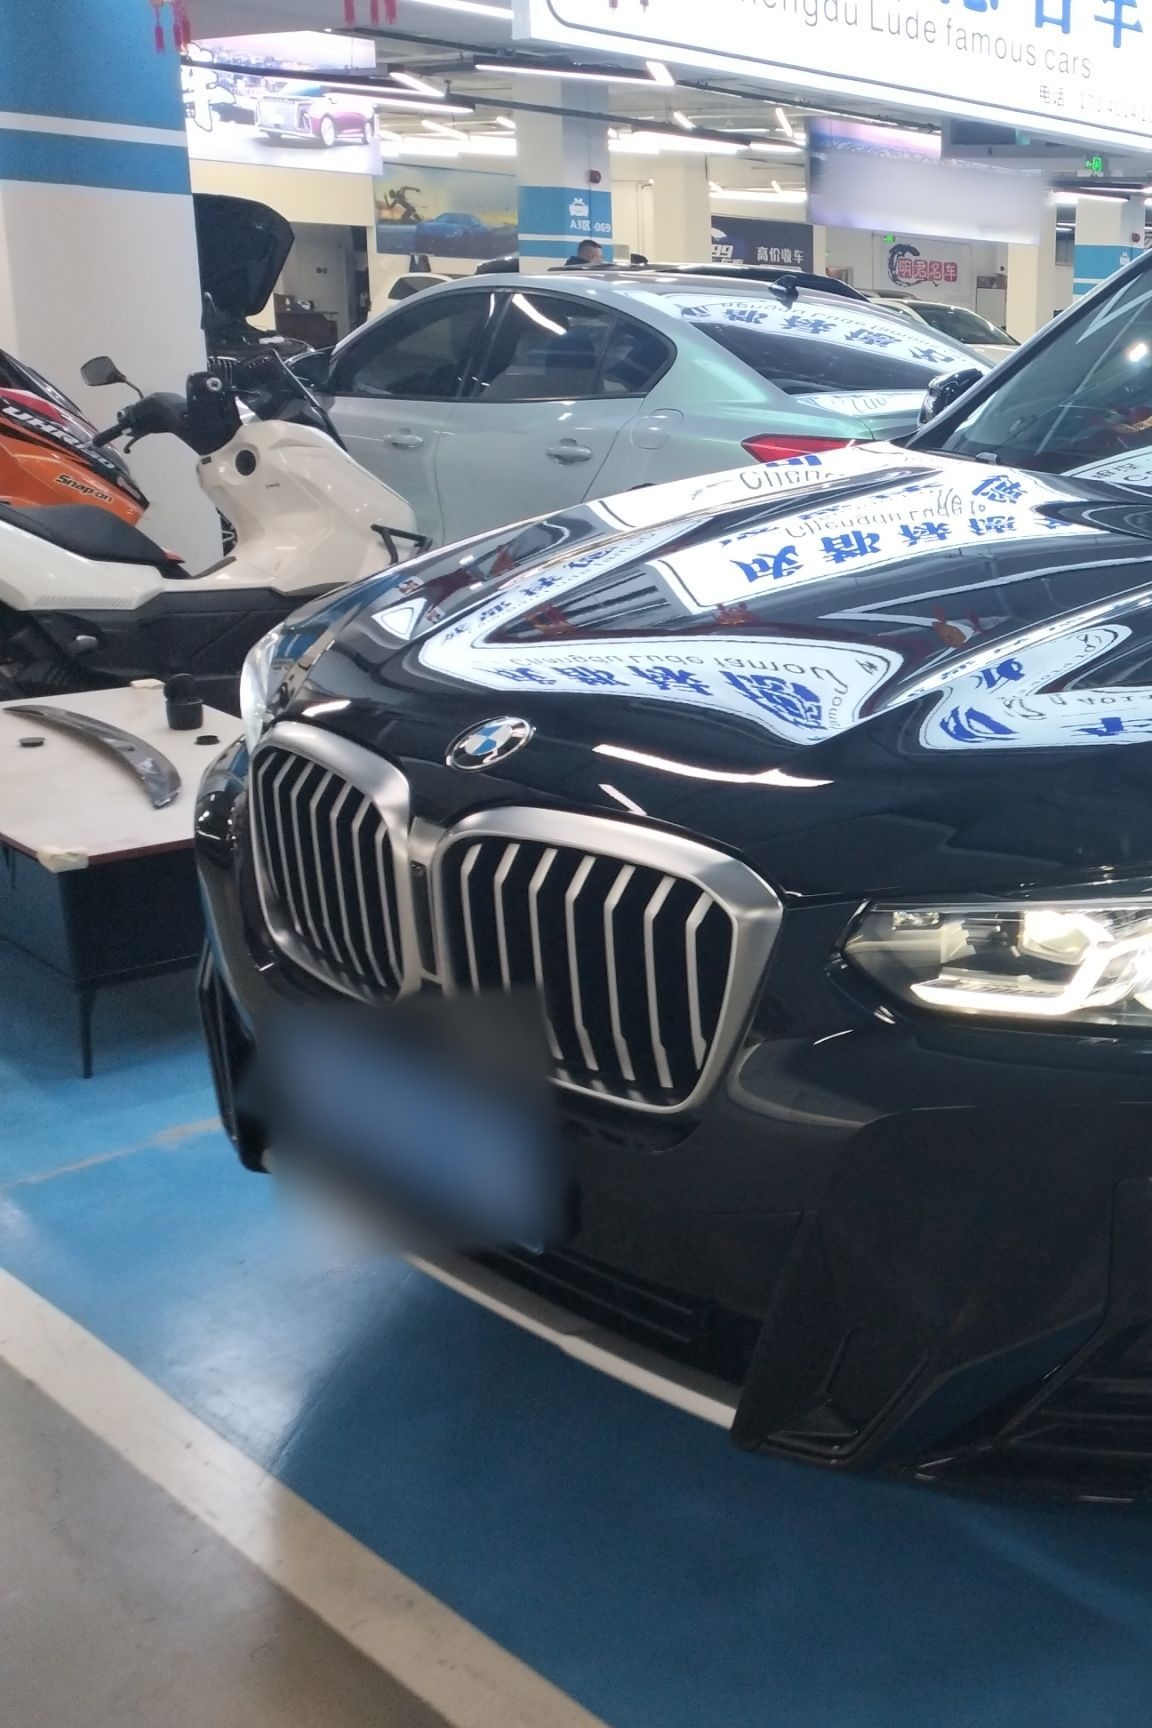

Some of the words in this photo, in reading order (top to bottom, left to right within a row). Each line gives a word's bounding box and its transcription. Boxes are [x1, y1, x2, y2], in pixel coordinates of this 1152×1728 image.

[870, 12, 937, 44] Lude
[946, 18, 1037, 67] famous
[1045, 49, 1092, 80] cars
[756, 246, 804, 264] 高价收车
[56, 474, 113, 503] Snap-on
